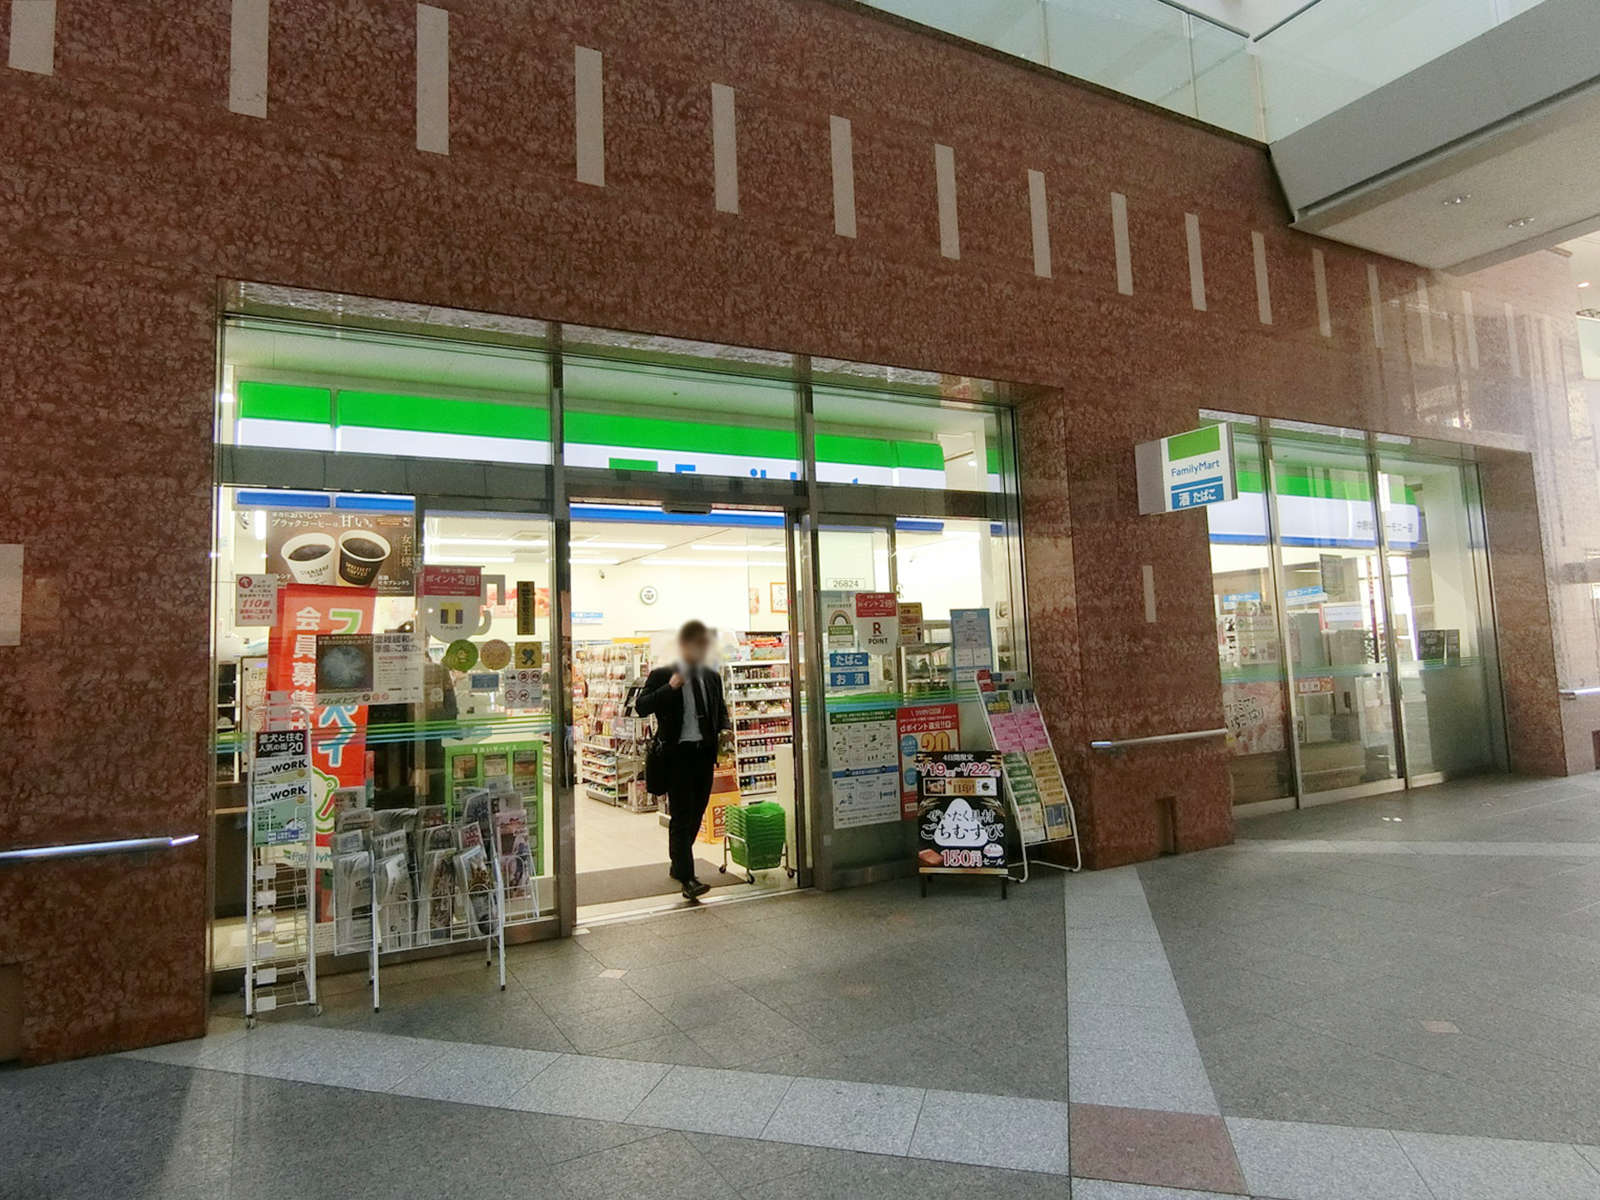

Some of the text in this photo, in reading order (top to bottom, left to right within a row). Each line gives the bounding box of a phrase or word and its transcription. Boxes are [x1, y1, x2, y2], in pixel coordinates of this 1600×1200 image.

[1171, 460, 1219, 476] FamilyMart
[1179, 489, 1216, 506] 酒 たばこ
[833, 579, 859, 588] 26824
[872, 622, 882, 635] R
[868, 637, 888, 645] POINT
[835, 655, 863, 666] たばこ
[259, 732, 304, 744] 愛犬と住む
[271, 759, 308, 773] WORK
[270, 785, 308, 801] WORK
[927, 809, 996, 822] ぜいたく具材
[920, 822, 1004, 841] ごちむすび
[941, 849, 983, 867] 150円
[984, 857, 1006, 866] セール
